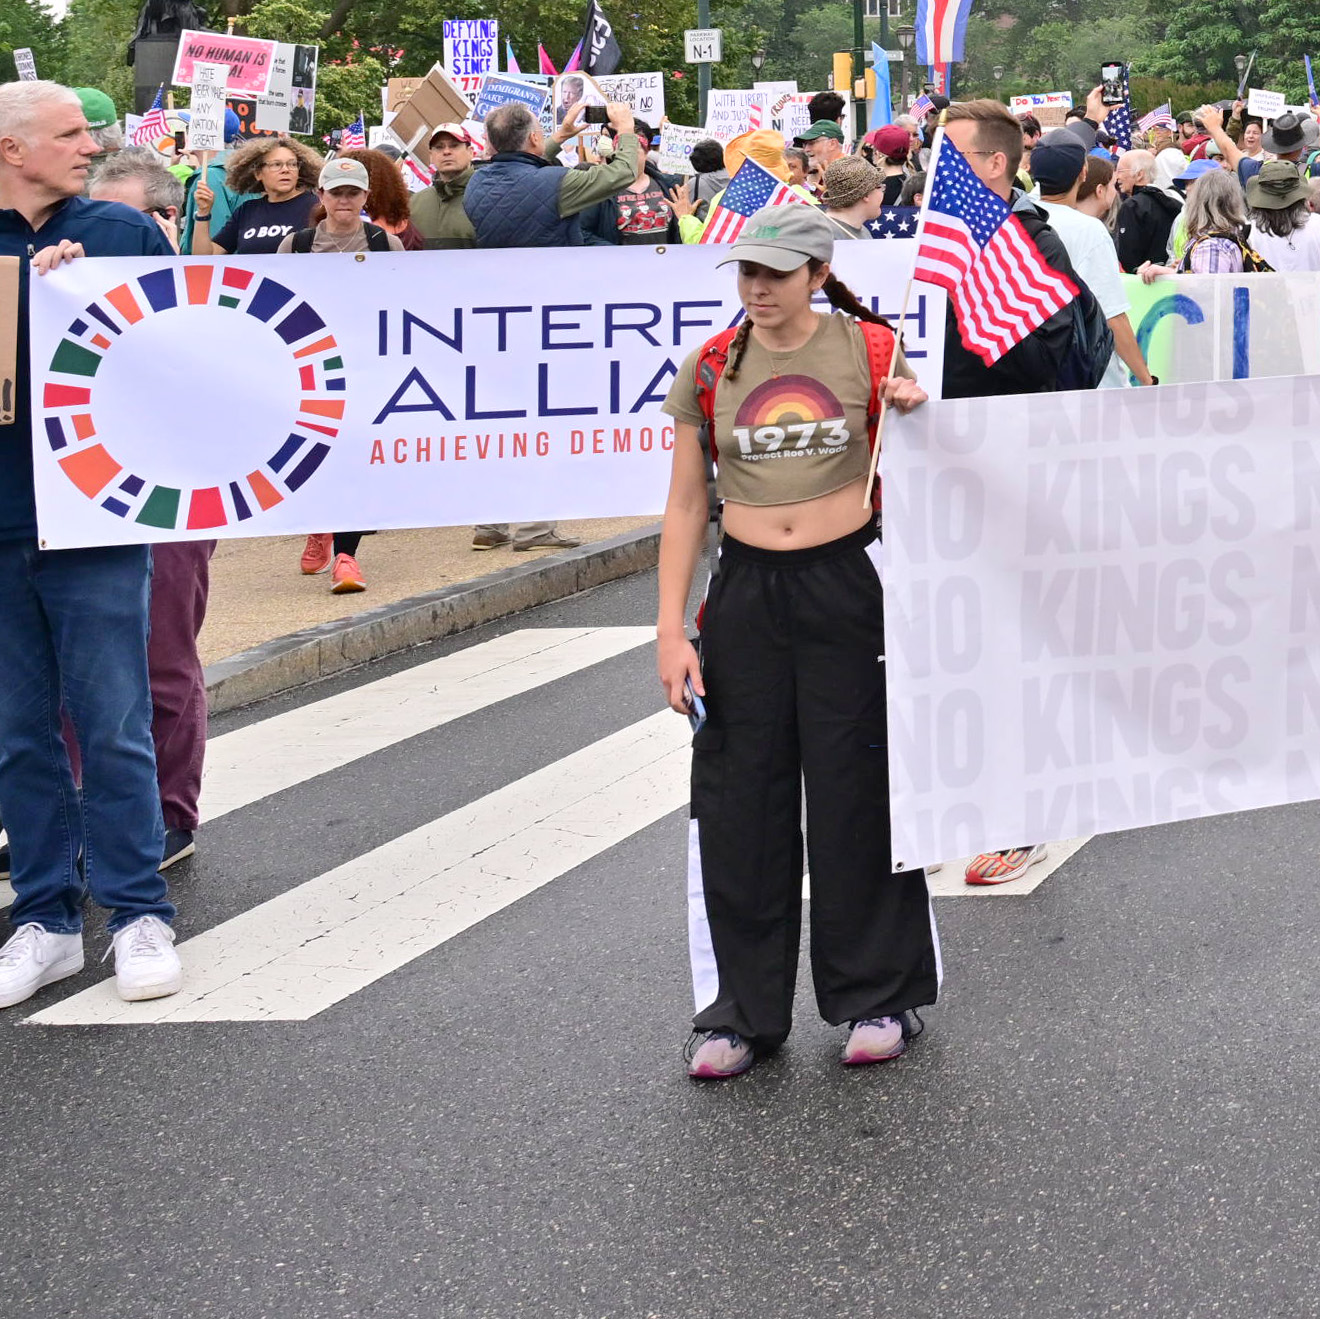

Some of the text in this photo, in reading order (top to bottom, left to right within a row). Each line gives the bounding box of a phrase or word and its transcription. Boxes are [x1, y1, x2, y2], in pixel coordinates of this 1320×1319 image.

[443, 20, 496, 38] DEFYING
[185, 44, 268, 66] NO HUMAN IS
[453, 39, 493, 57] KINGS
[693, 44, 713, 59] N-1
[453, 59, 491, 76] SINCE
[480, 93, 503, 105] MAKE
[488, 84, 541, 103] IMMIGRANTS
[714, 94, 736, 107] WITH
[197, 104, 213, 114] ANY
[640, 97, 653, 109] NO
[712, 109, 751, 121] AND JUST
[192, 119, 218, 131] NATION
[192, 134, 217, 147] GREAT
[243, 224, 293, 240] O BOY
[378, 293, 926, 357] INTERFH
[570, 426, 675, 456] DEMOC
[732, 418, 851, 454] 1973
[370, 427, 549, 465] ACHIEVING
[741, 445, 849, 462] Protect Roe V. Wade
[1024, 444, 1256, 557] KINGS
[1019, 550, 1256, 663] KINGS
[1021, 654, 1252, 775] KINGS
